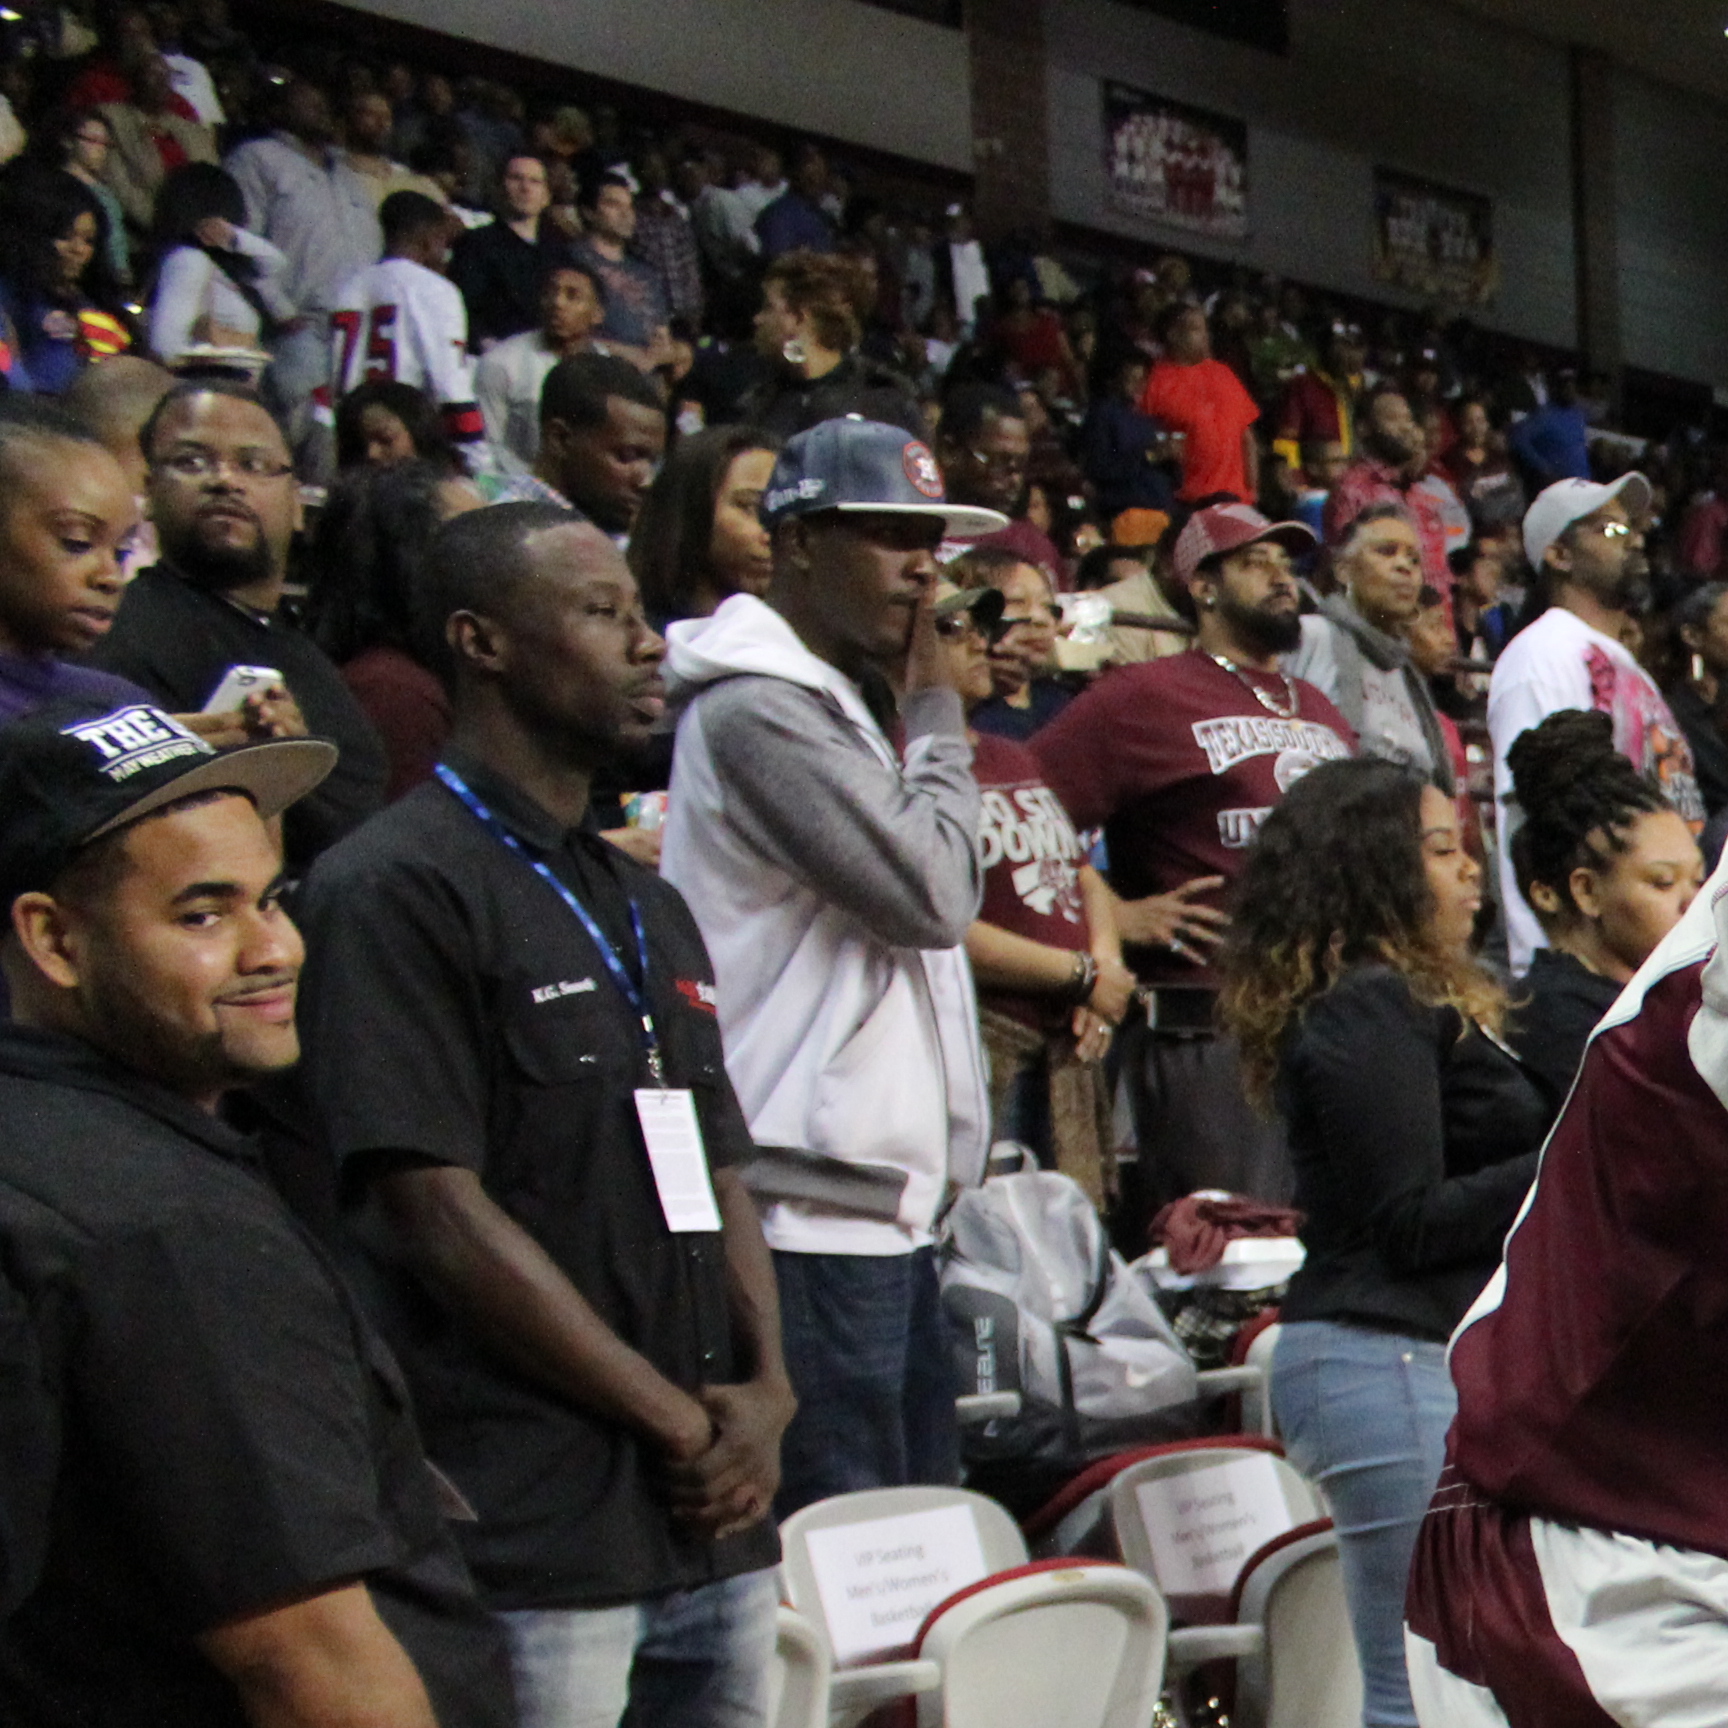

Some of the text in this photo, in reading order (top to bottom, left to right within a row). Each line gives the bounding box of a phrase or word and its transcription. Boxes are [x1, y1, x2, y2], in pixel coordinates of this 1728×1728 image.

[329, 304, 397, 394] 75
[74, 708, 172, 760] THE
[1192, 716, 1273, 774] TEXAS
